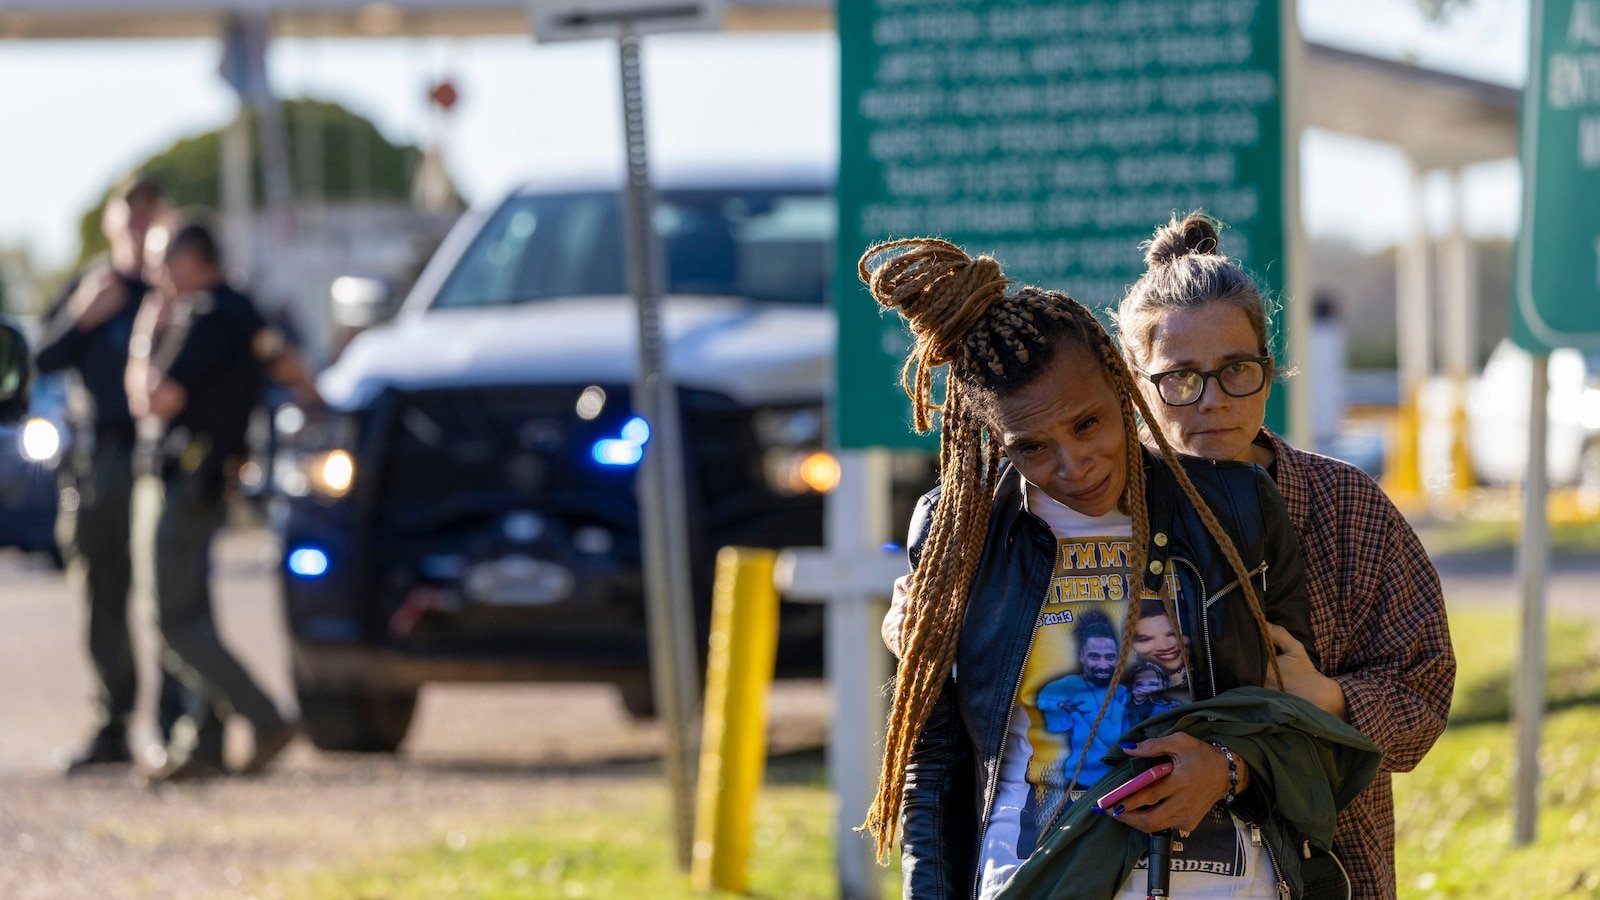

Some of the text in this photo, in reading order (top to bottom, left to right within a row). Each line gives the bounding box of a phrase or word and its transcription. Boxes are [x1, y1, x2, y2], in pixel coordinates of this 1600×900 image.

[1062, 542, 1097, 570] I'M
[1044, 610, 1073, 625] 20:13
[1132, 857, 1231, 875] MRDER!
